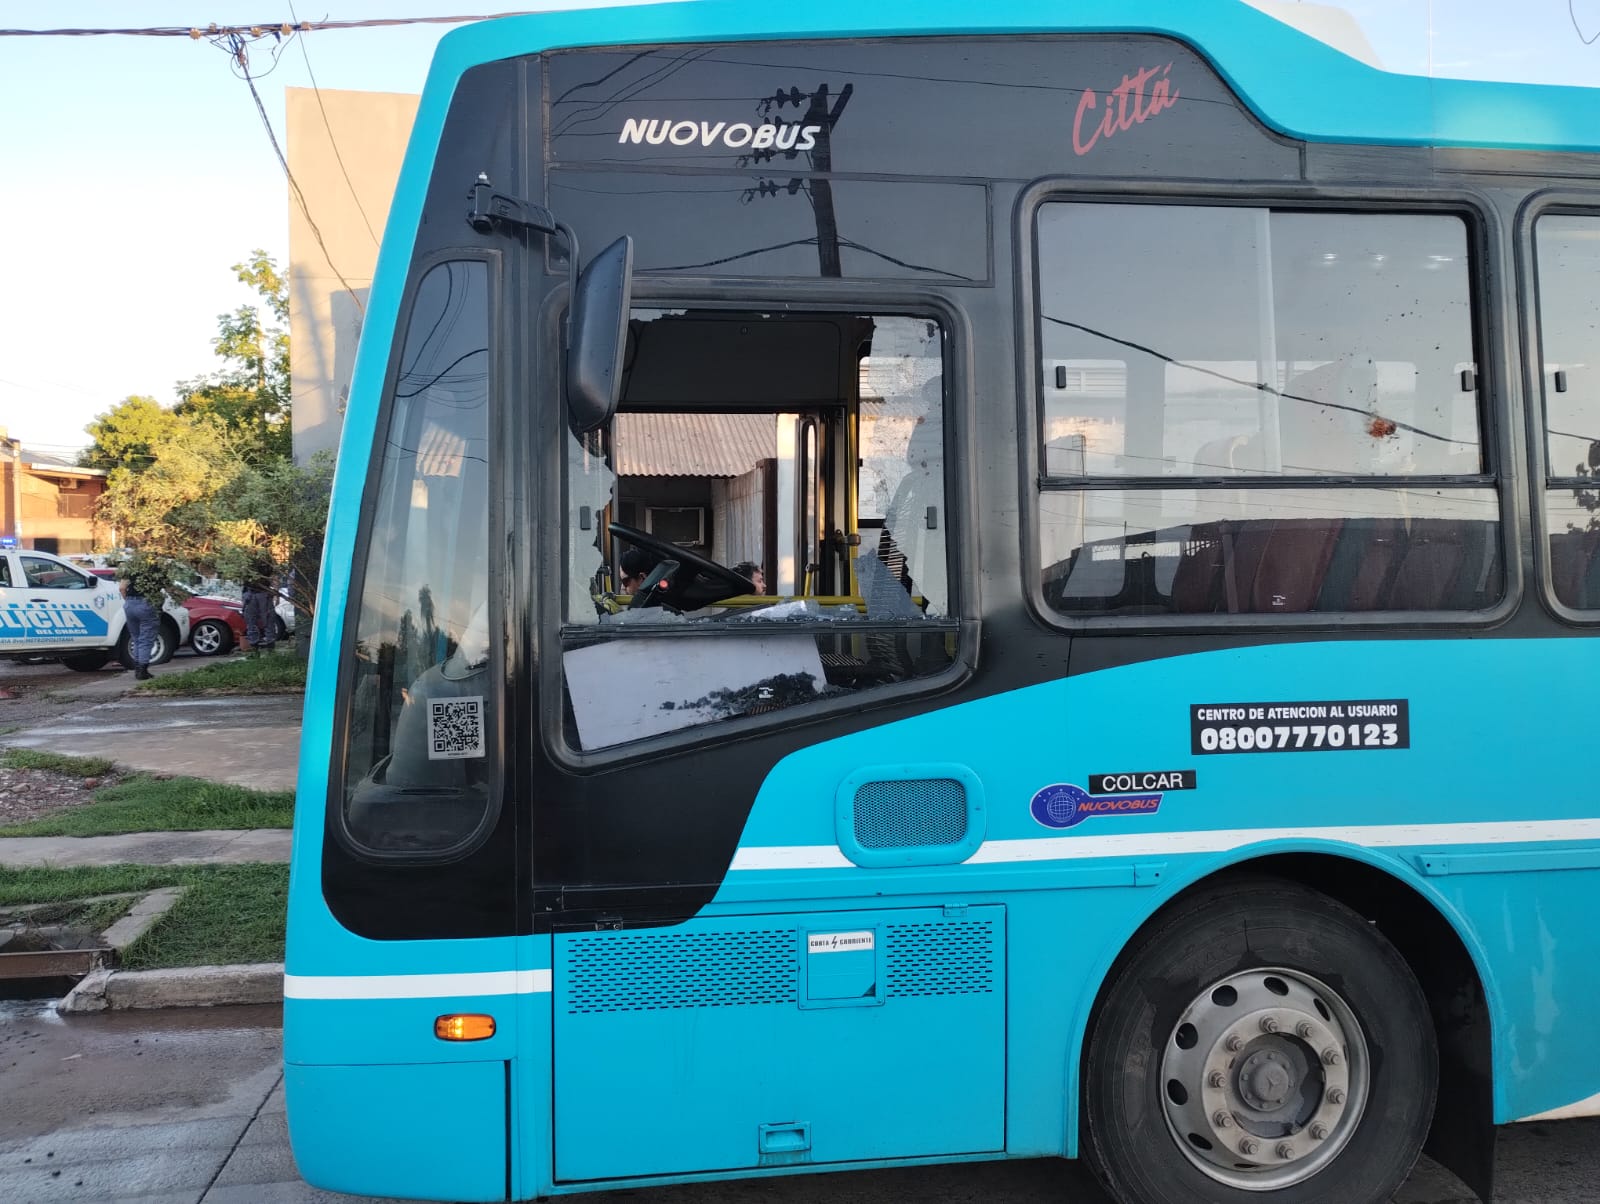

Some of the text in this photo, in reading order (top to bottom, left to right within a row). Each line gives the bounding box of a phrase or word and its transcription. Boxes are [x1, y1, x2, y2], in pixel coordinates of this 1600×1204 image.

[618, 118, 821, 150] NUOVOBUS
[1197, 704, 1398, 721] CENTRO DE ATENCION AL USUARIO
[1200, 723, 1399, 750] 08007770123
[1102, 772, 1184, 792] COLCAR
[1078, 798, 1160, 812] NUOVOBUS
